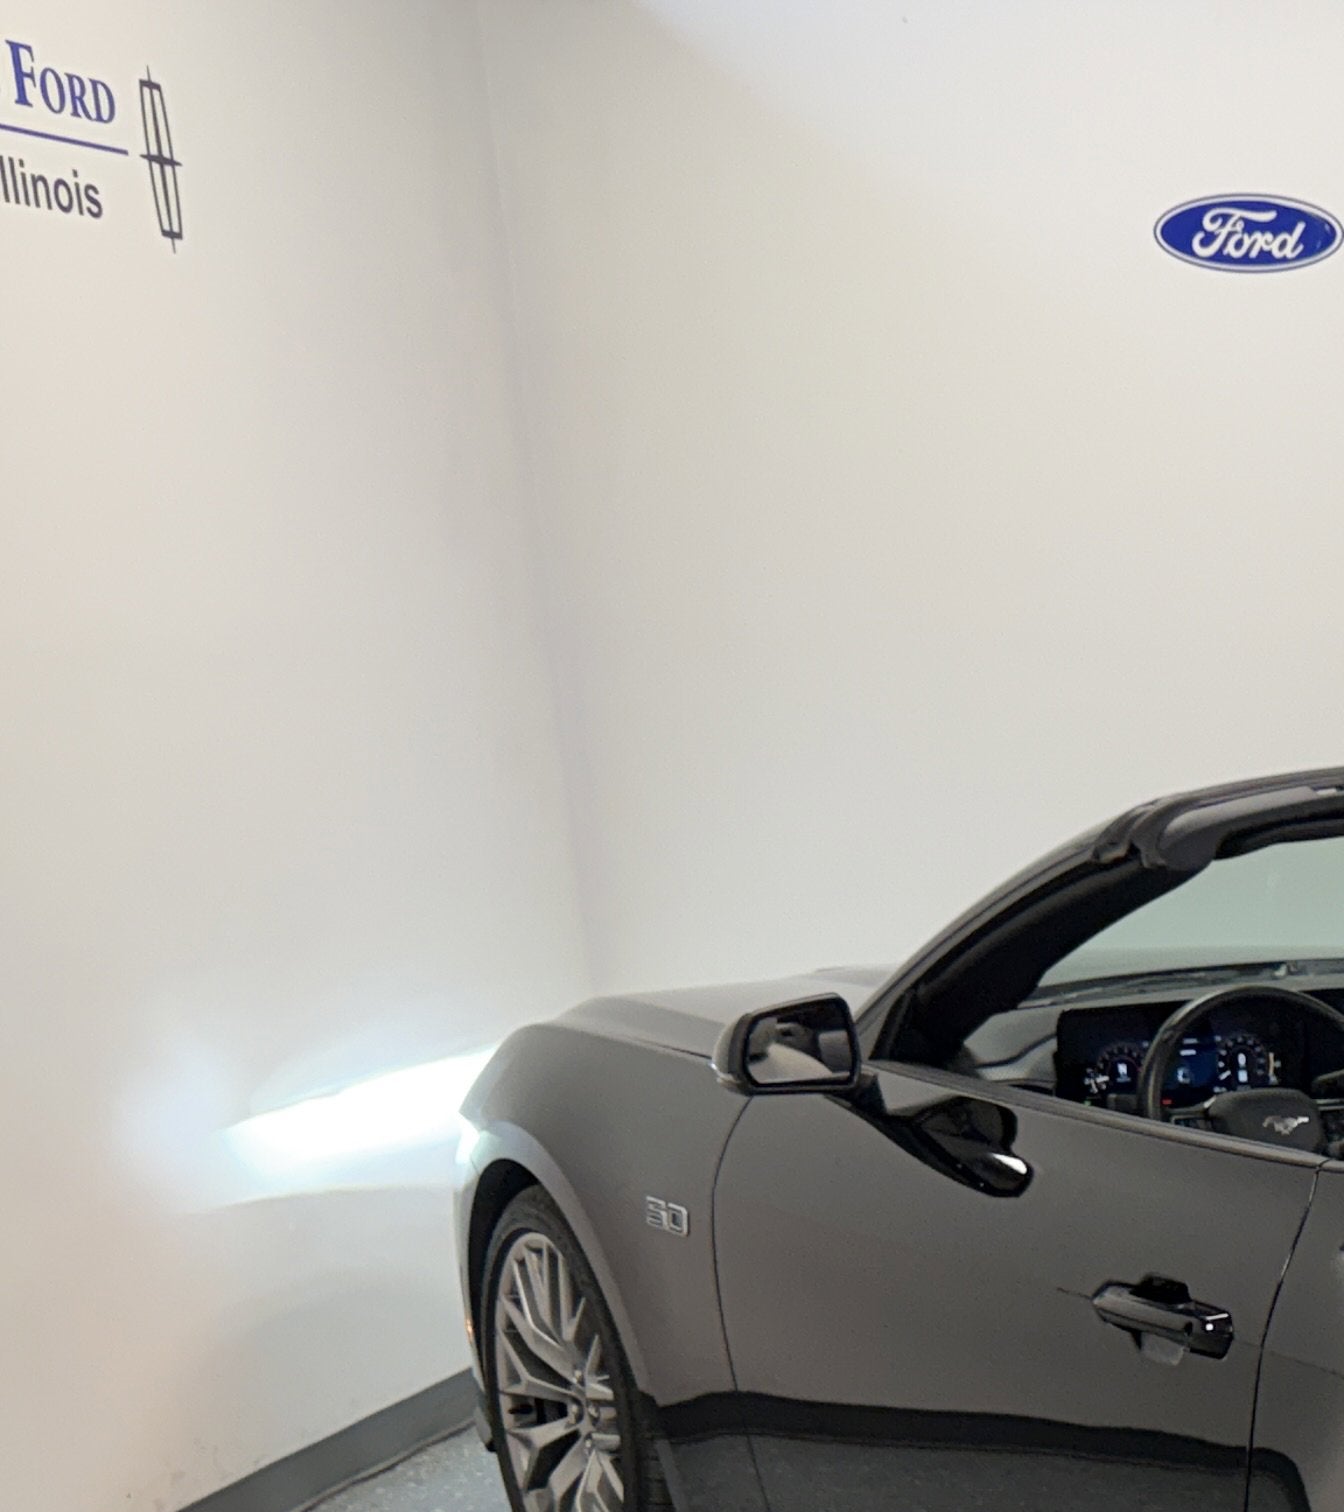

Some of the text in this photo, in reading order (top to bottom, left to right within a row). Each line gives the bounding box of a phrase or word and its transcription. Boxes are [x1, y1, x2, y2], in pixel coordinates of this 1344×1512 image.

[5, 39, 116, 124] FORD
[0, 154, 104, 220] llinois
[1191, 207, 1306, 260] Ford
